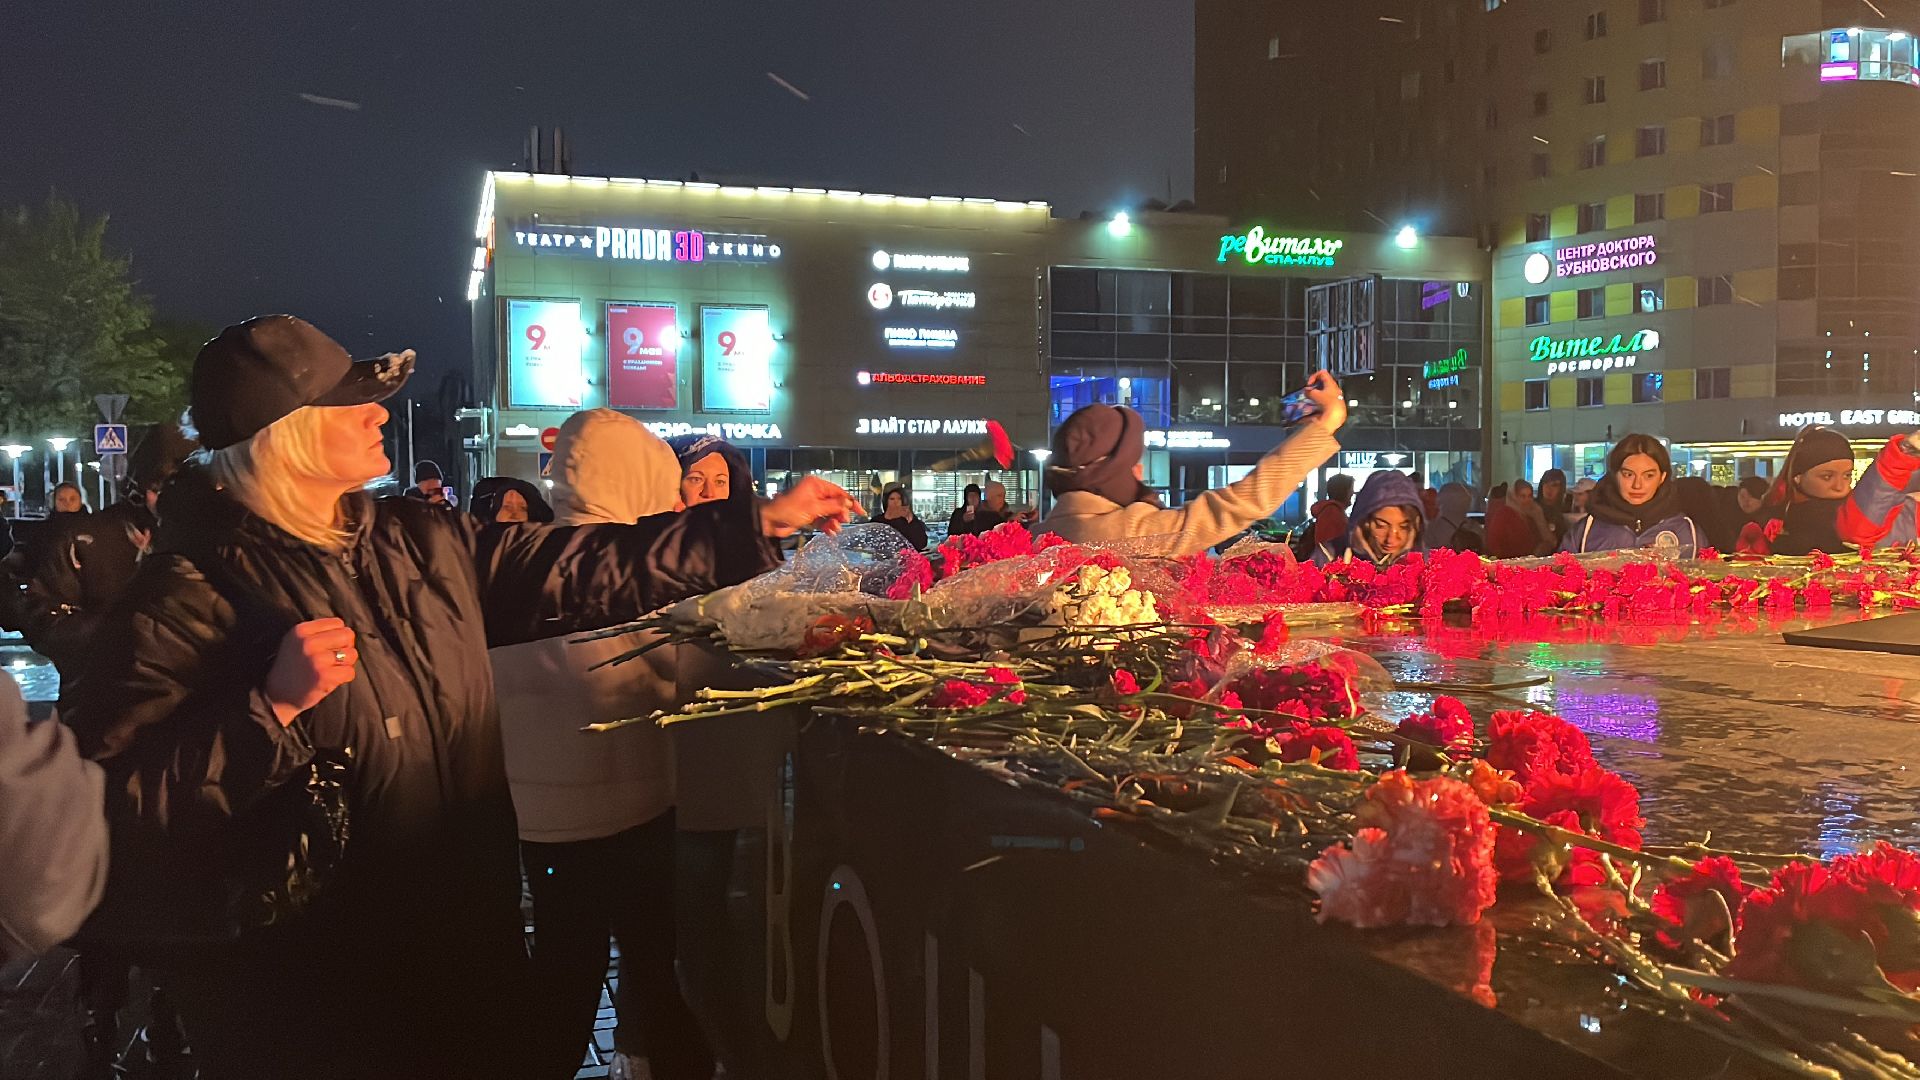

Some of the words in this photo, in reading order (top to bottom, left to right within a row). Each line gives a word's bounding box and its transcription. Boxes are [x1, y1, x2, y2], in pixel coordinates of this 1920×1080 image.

[515, 231, 576, 249] ТЕАТР
[596, 226, 672, 262] PRADA
[674, 230, 705, 262] 3D
[722, 242, 782, 257] КИНО
[1556, 243, 1597, 262] ЦЕНТР
[1597, 235, 1655, 257] ДОКТОРА
[1264, 254, 1335, 266] СПА-КЛУБ
[1556, 250, 1656, 277] БУБНОВСКОГО
[525, 324, 546, 351] 9
[717, 330, 737, 357] 9
[1547, 355, 1637, 375] ресторан
[872, 373, 986, 385] АЛЬФАСТРАХОВАНИЕ
[871, 415, 906, 434] ВАЙТ
[907, 419, 941, 434] СТАР
[943, 419, 988, 434] ЛАУНЖ
[1779, 411, 1835, 427] HOTEL
[1840, 409, 1886, 425] EAST
[721, 422, 782, 440] ТОЧКА
[1345, 452, 1377, 465] MIUZ
